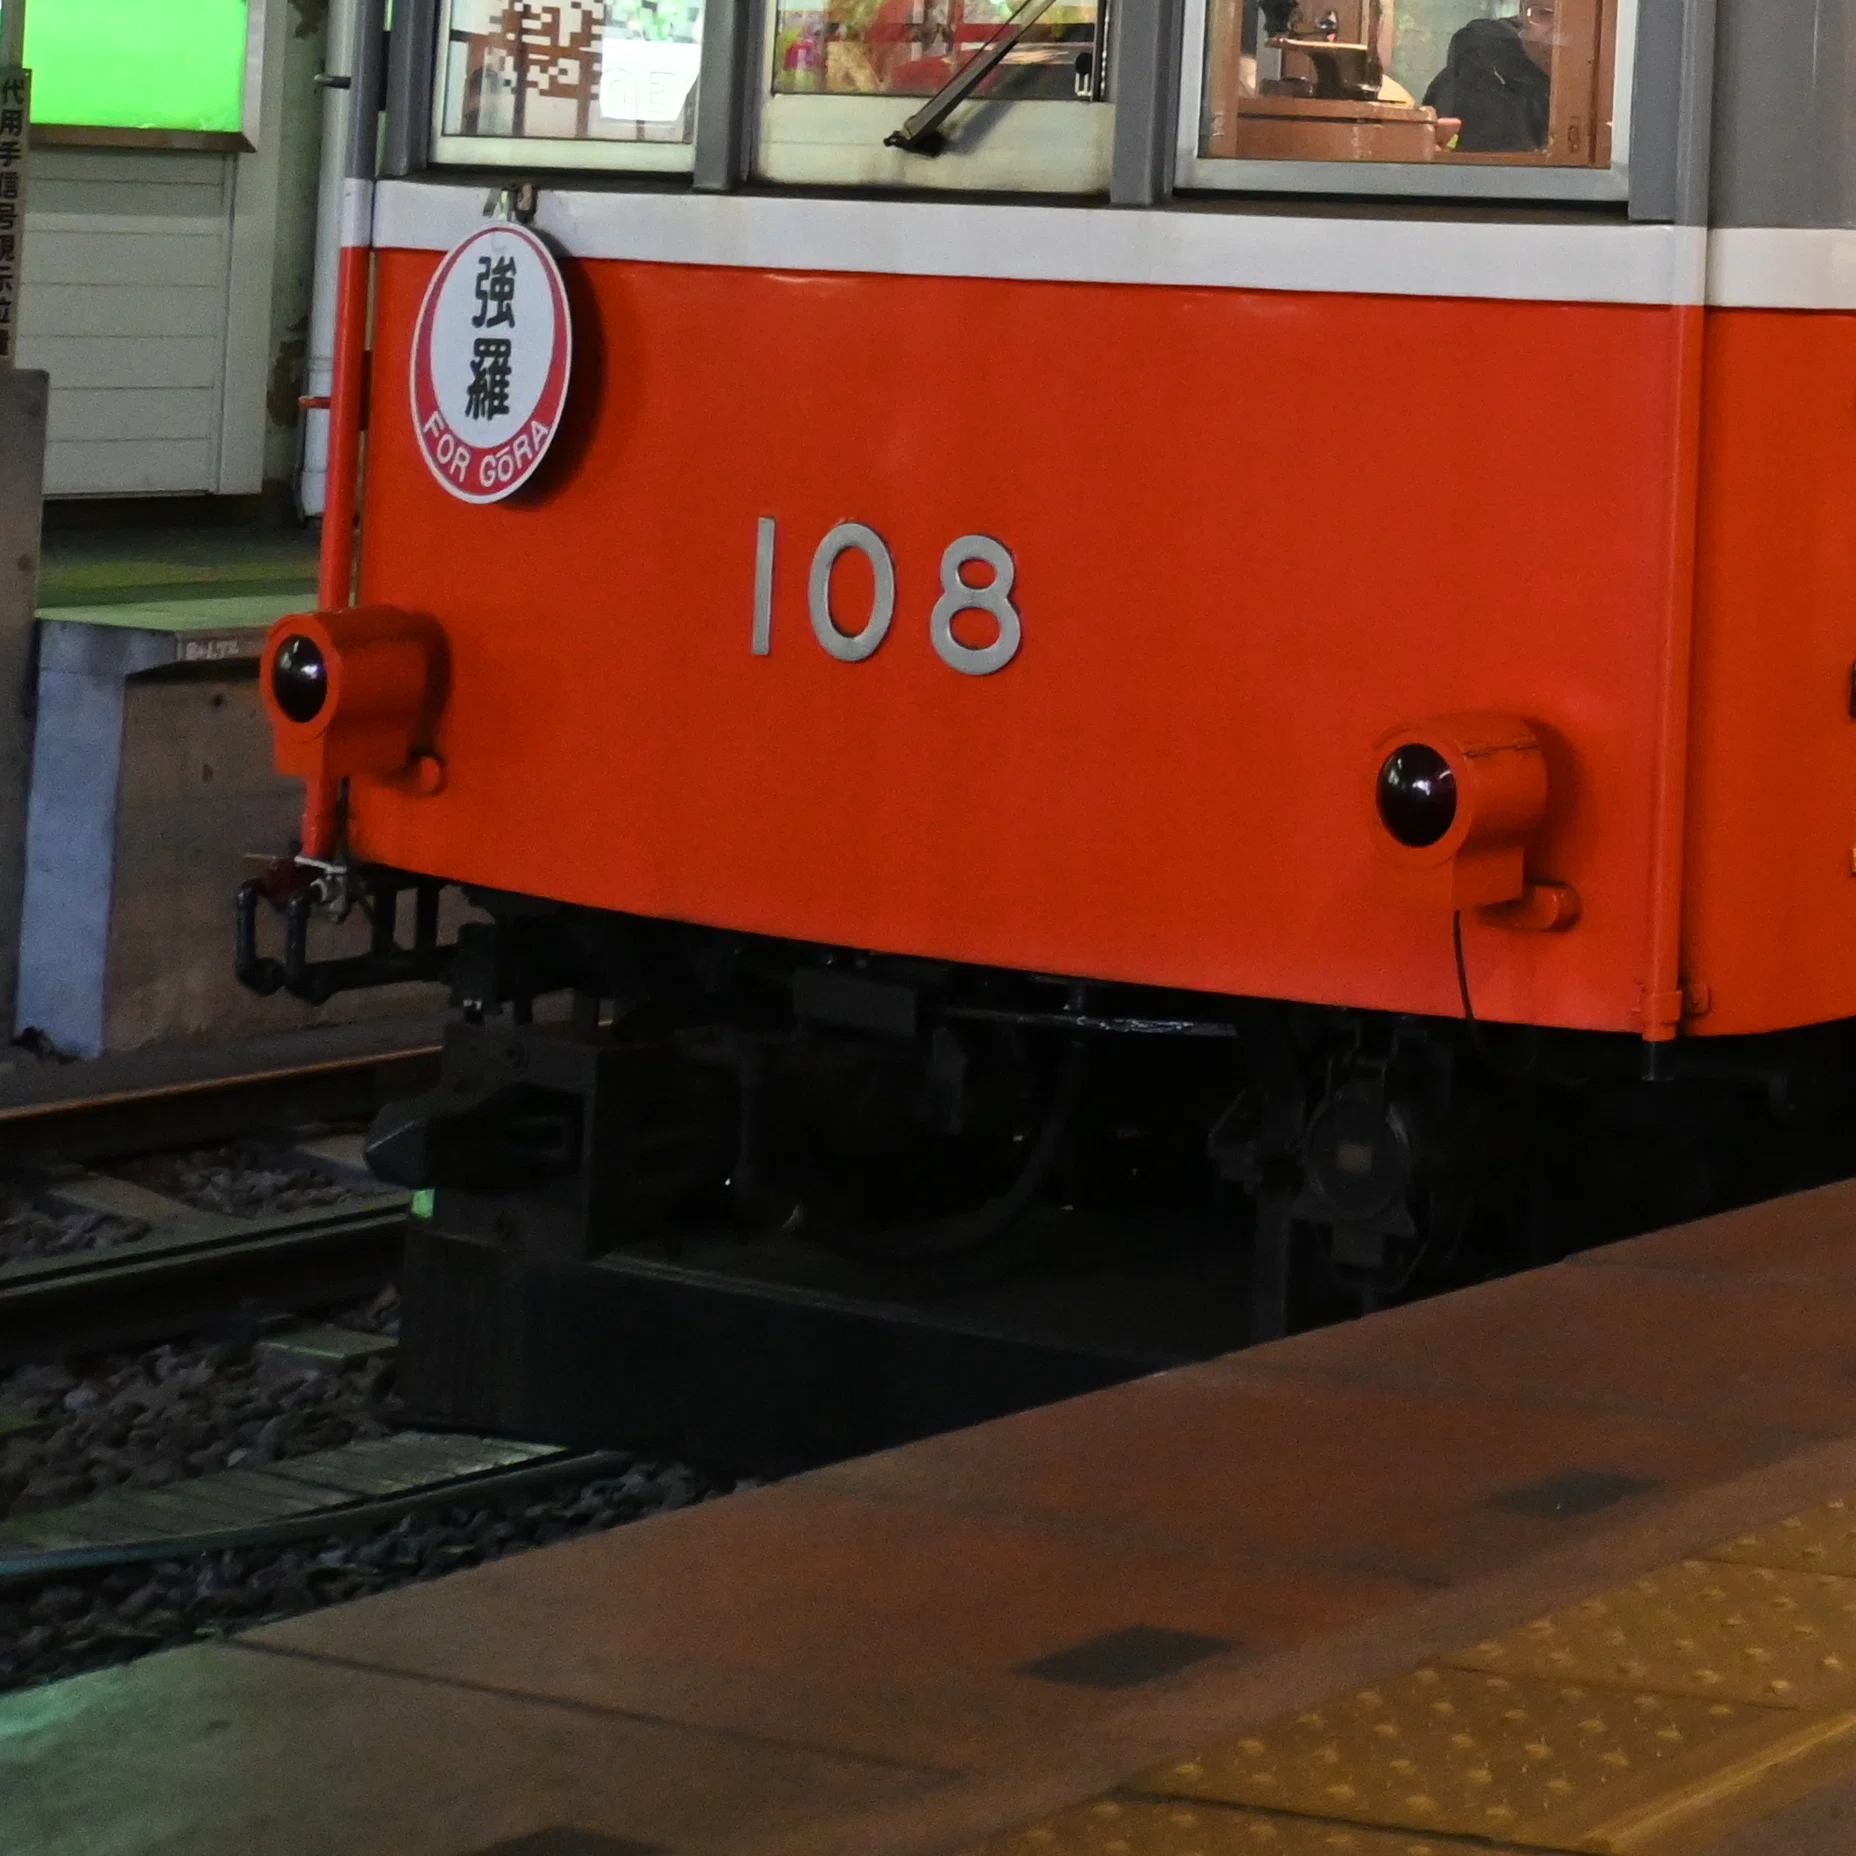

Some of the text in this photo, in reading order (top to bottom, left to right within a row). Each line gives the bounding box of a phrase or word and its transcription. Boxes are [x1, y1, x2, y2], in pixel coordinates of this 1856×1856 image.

[463, 256, 517, 422] 強羅
[423, 410, 471, 483] FOR
[751, 516, 1022, 677] 108
